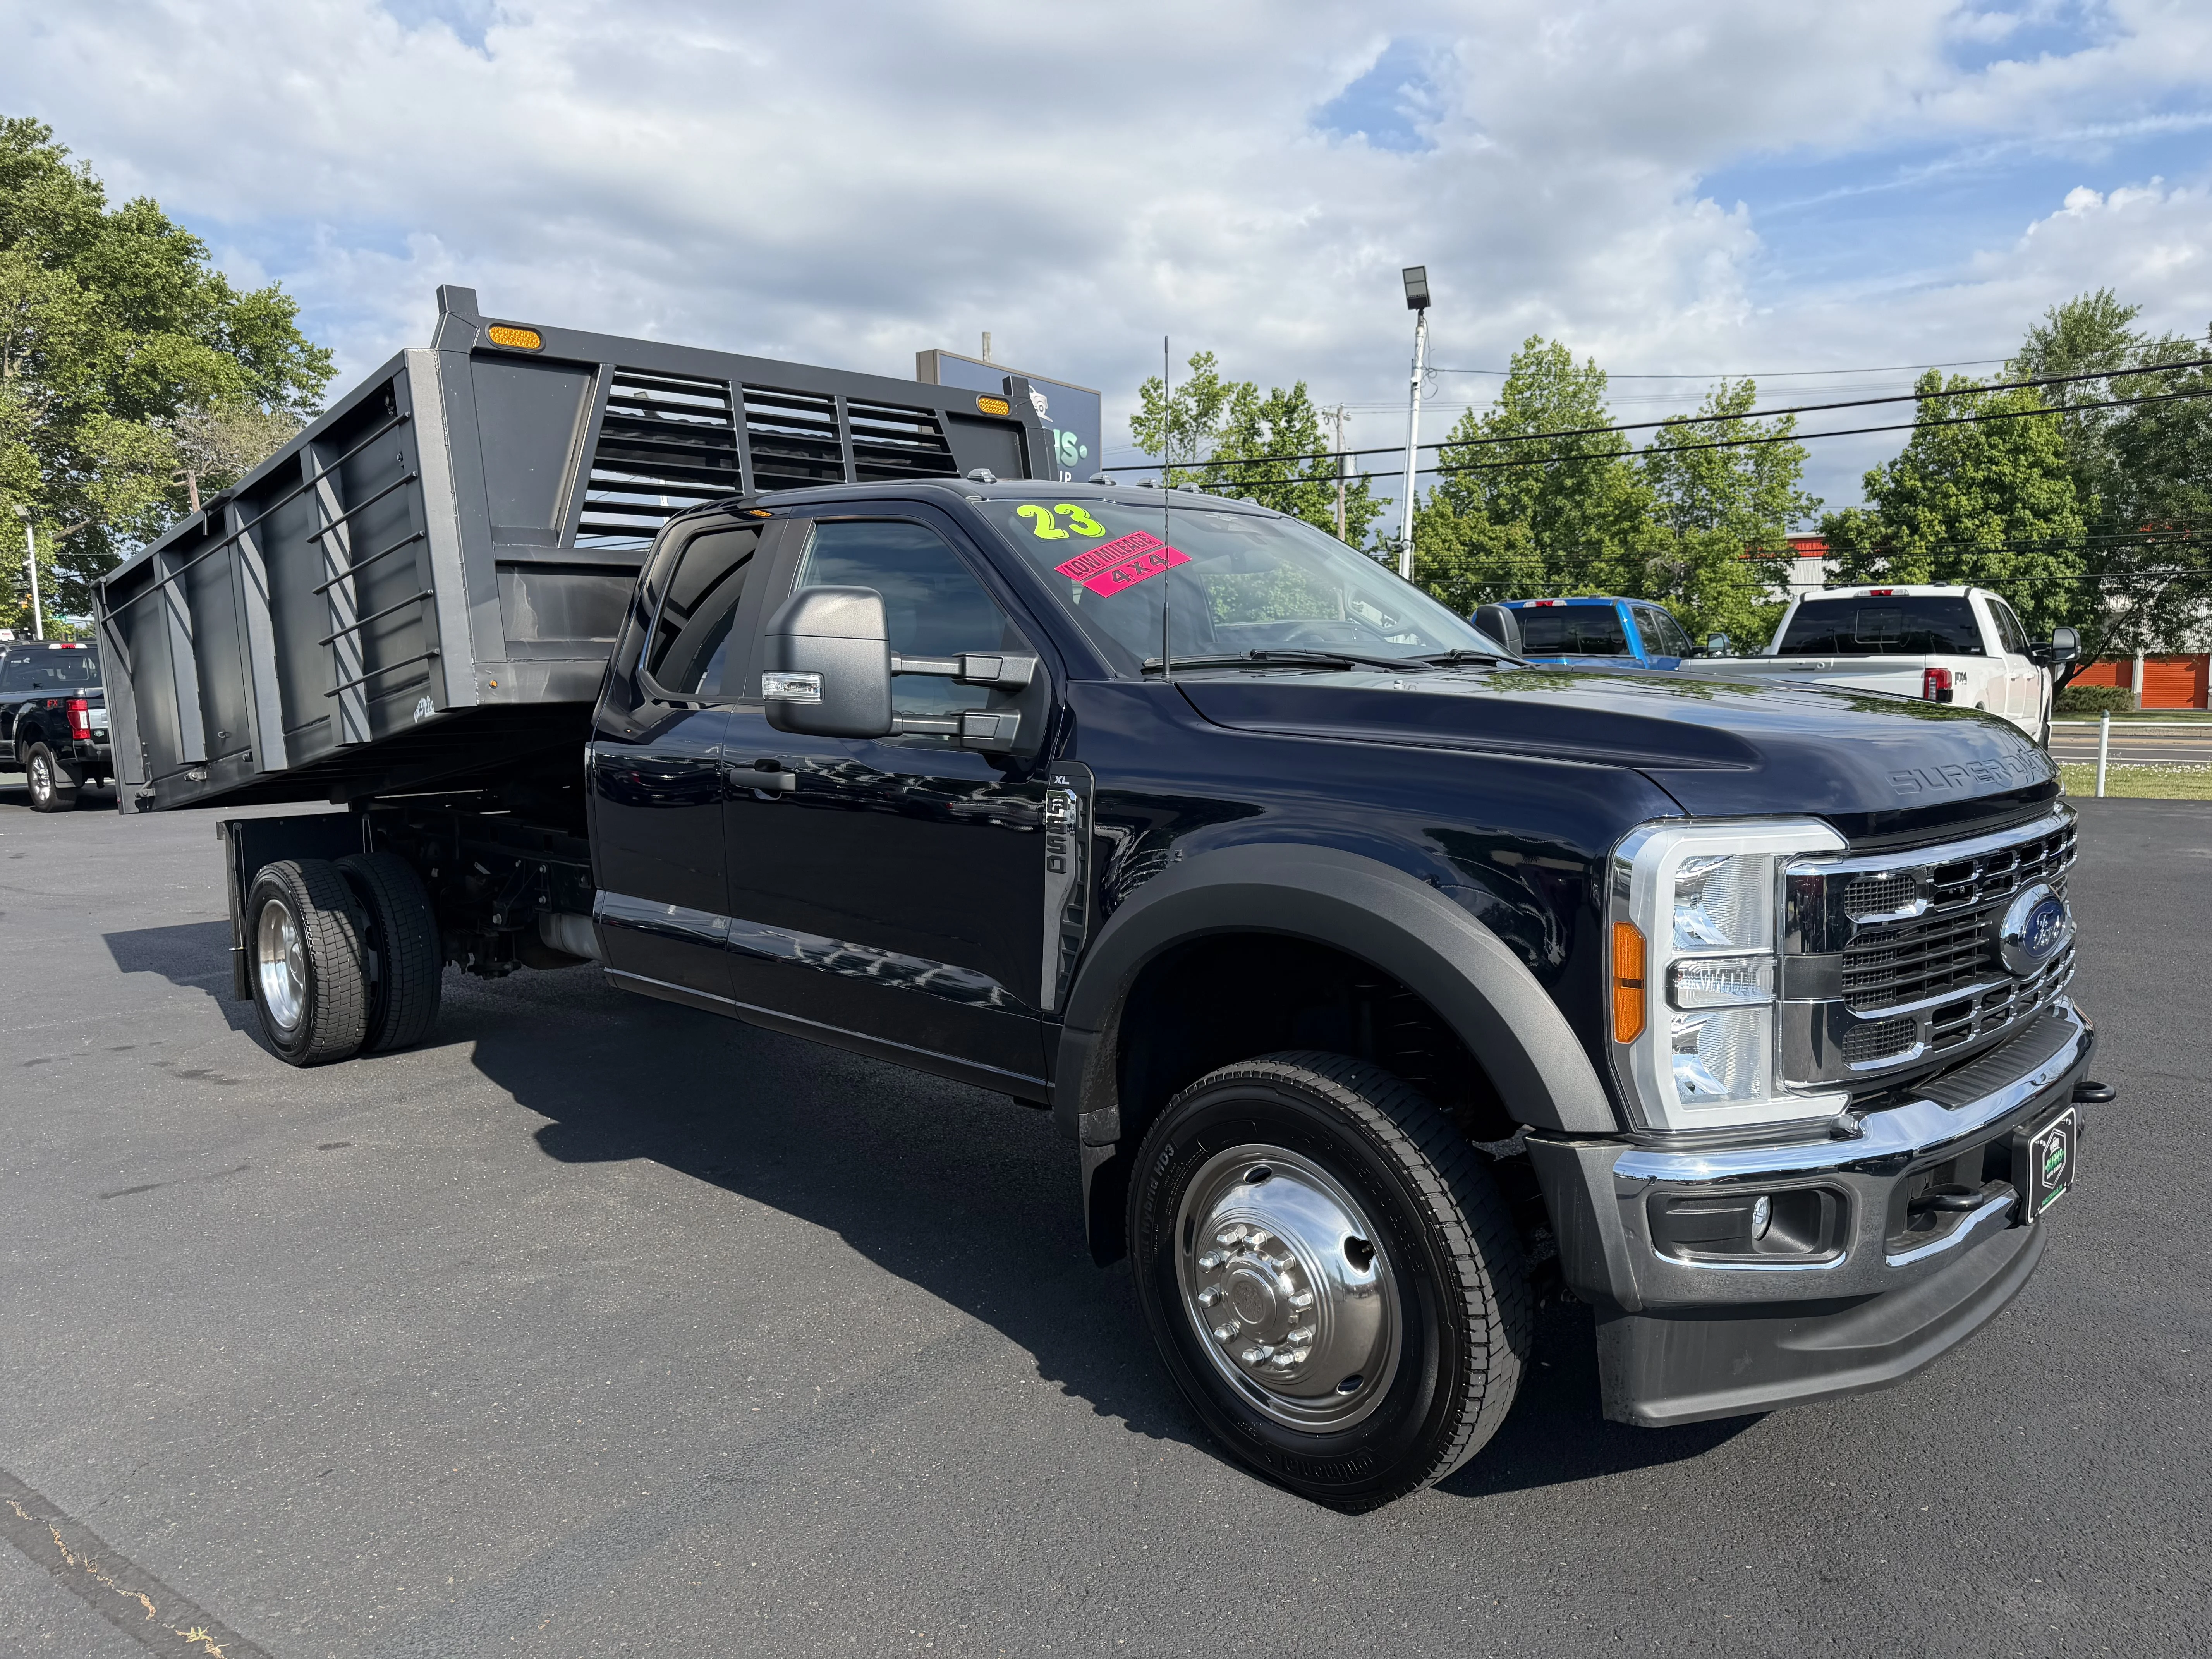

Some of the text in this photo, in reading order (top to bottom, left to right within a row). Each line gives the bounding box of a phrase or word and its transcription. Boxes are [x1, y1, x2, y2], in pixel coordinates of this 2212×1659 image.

[1017, 503, 1106, 540] 23
[1065, 533, 1154, 577] LOW MILEAGE
[1054, 775, 1070, 785] XL
[1885, 759, 2013, 795] SUPER
[2047, 1148, 2063, 1173] BURNS
[1140, 1177, 1159, 1234] Hybrid
[1154, 1143, 1175, 1176] HD3
